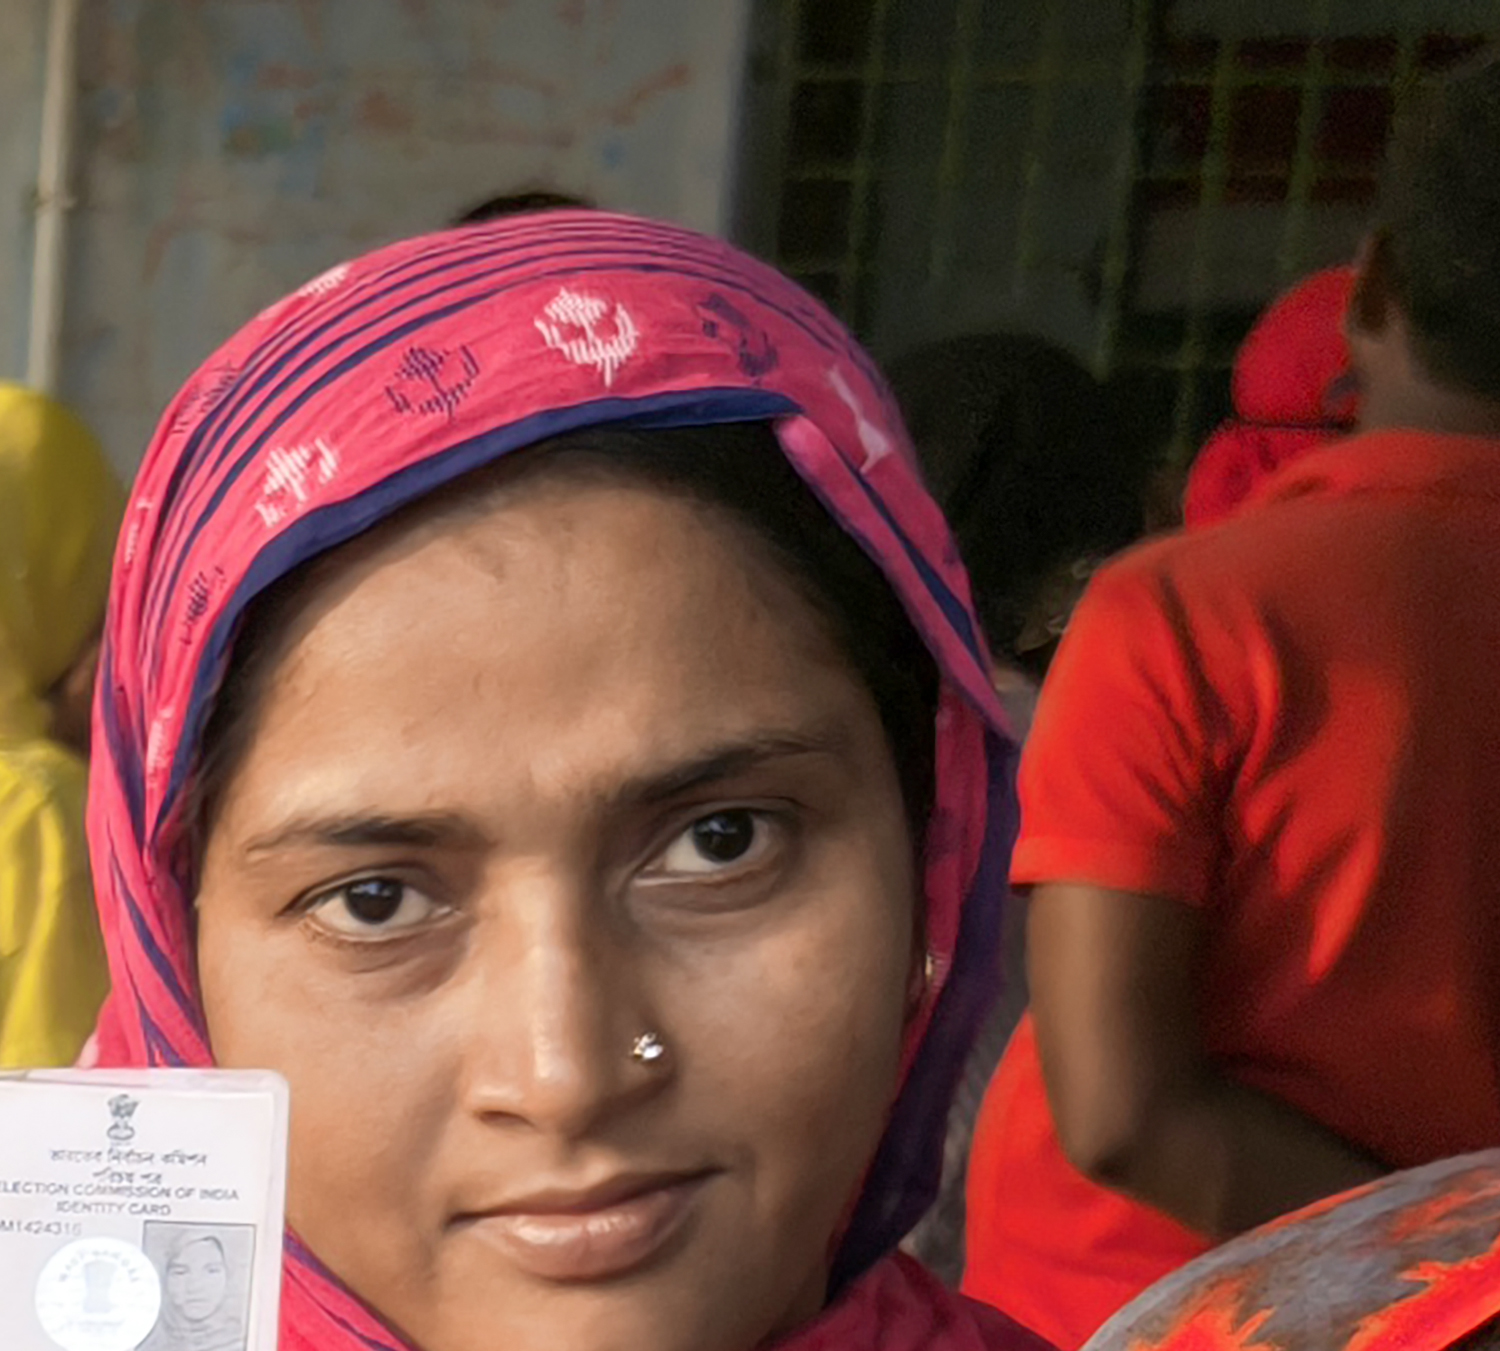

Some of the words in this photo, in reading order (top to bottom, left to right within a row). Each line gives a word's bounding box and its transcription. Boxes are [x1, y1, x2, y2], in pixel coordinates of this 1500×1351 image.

[73, 1182, 171, 1199] COMMISSION
[174, 1187, 195, 1200] OF
[199, 1188, 240, 1201] INDIA
[56, 1200, 126, 1214] IDENTITY
[128, 1202, 171, 1216] CARD
